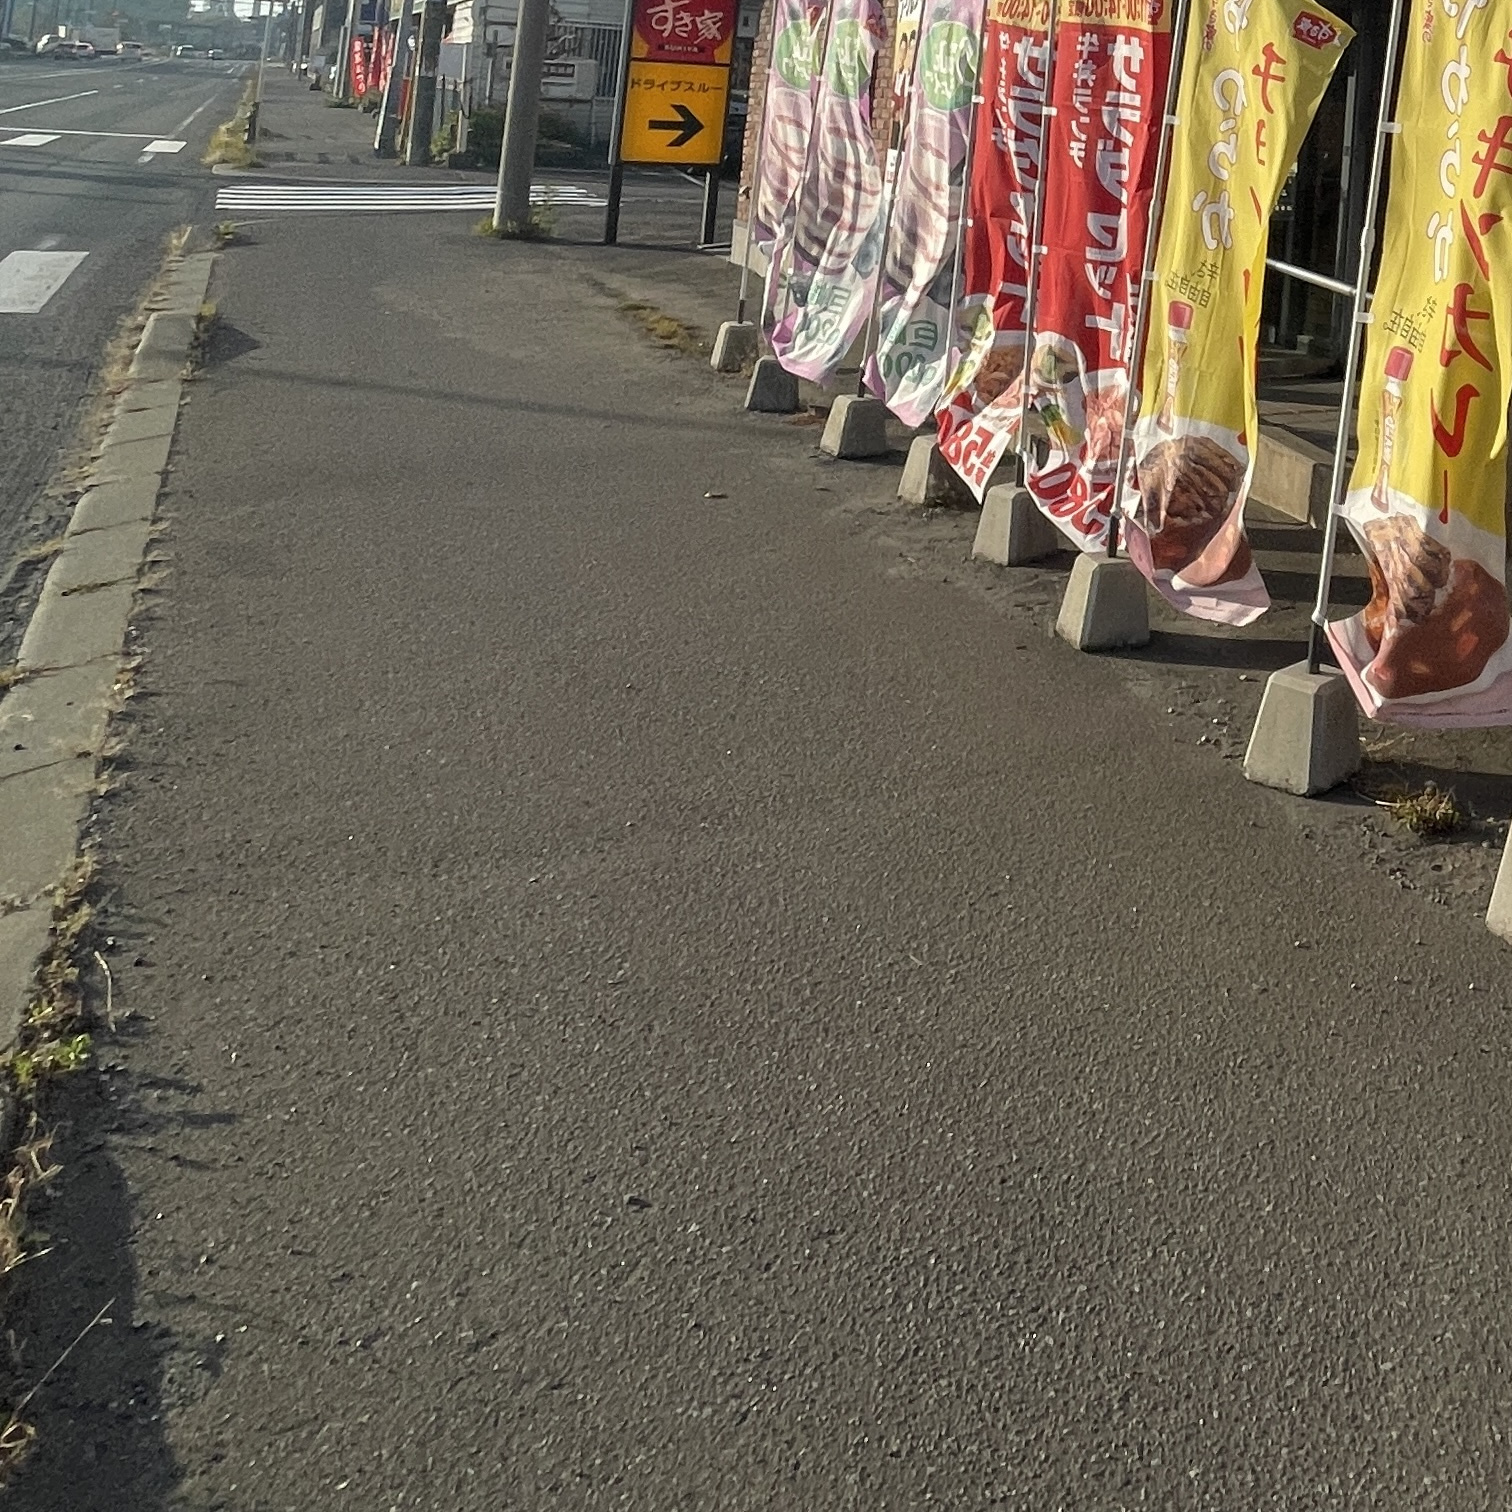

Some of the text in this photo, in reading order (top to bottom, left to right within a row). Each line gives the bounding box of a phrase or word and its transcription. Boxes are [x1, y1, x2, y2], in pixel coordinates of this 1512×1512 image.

[631, 78, 722, 93] ドライブスルー
